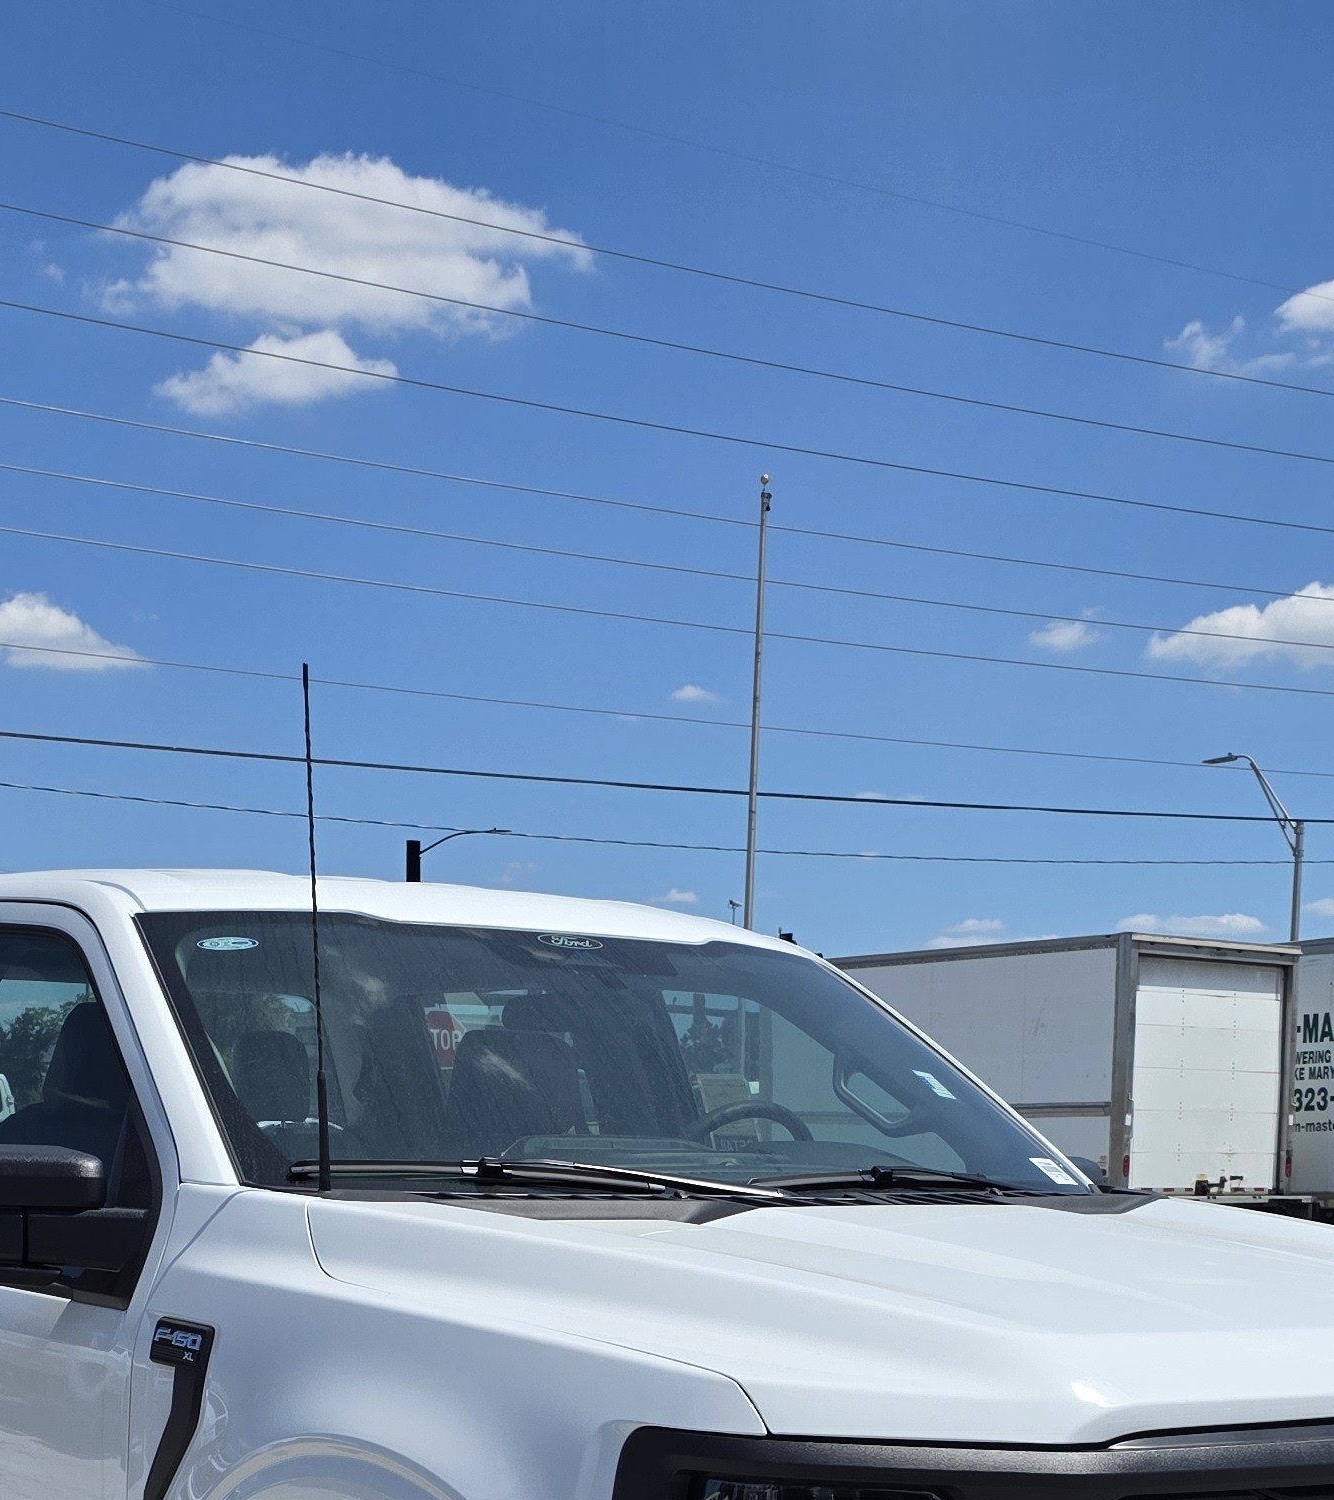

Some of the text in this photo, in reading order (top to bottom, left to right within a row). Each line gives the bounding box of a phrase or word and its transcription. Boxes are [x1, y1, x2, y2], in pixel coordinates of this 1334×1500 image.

[551, 935, 593, 948] Ford
[429, 1029, 463, 1051] TOP
[154, 1327, 202, 1351] F-150
[182, 1351, 194, 1362] XL
